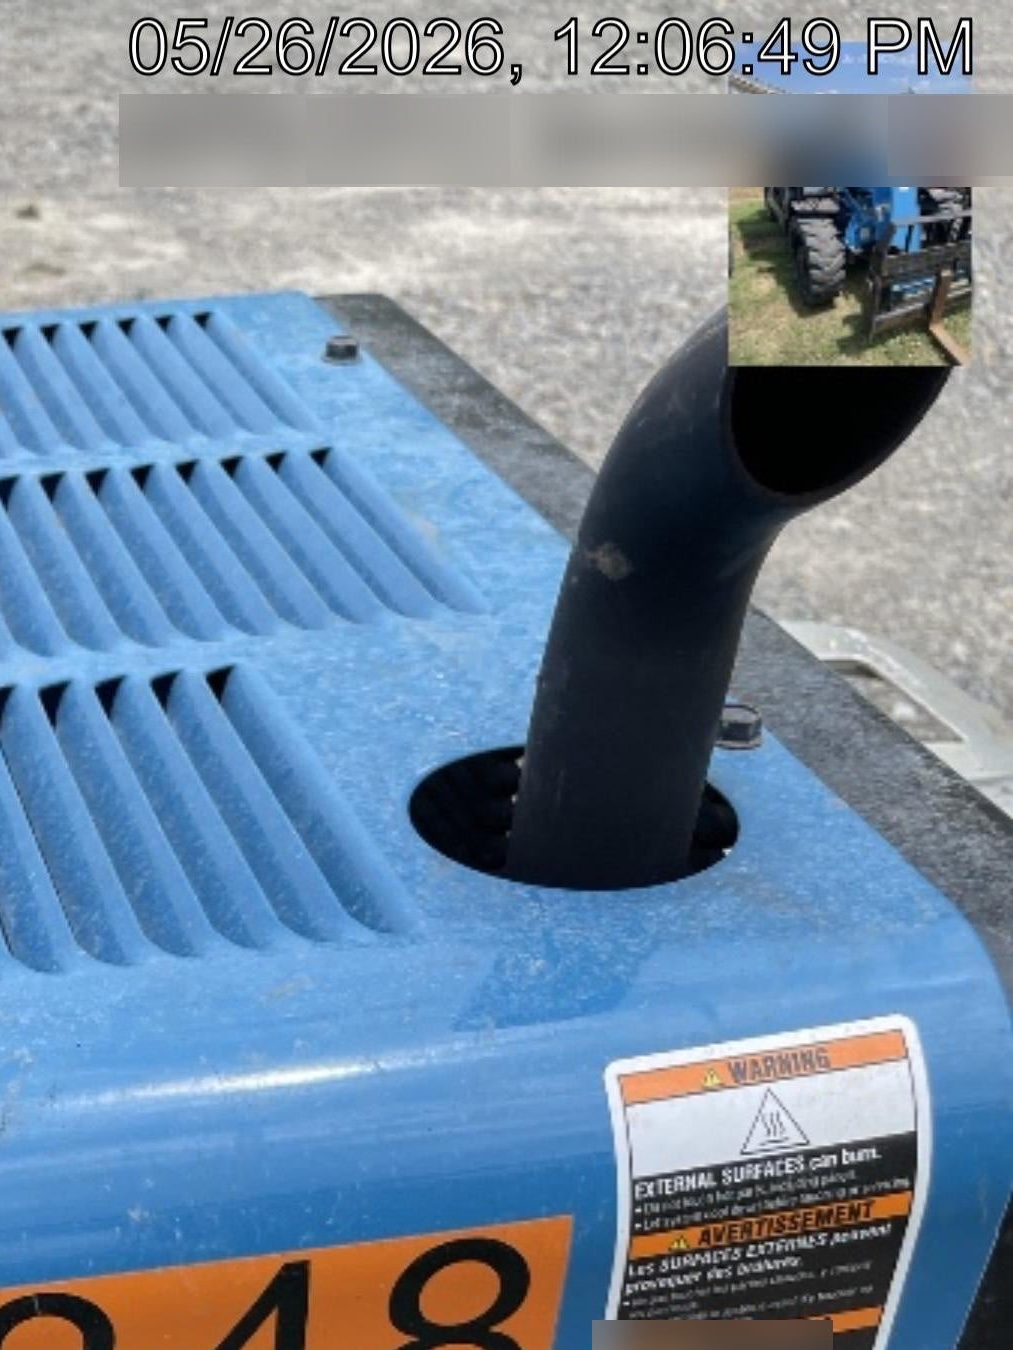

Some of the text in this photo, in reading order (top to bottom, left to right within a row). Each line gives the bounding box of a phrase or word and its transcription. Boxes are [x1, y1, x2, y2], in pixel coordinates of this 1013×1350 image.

[727, 1045, 831, 1085] WARNING
[634, 1172, 717, 1199] EXTERNAL
[721, 1156, 805, 1185] SURFACES
[809, 1153, 838, 1170] can
[697, 1200, 876, 1247] AVERTISSEMENT
